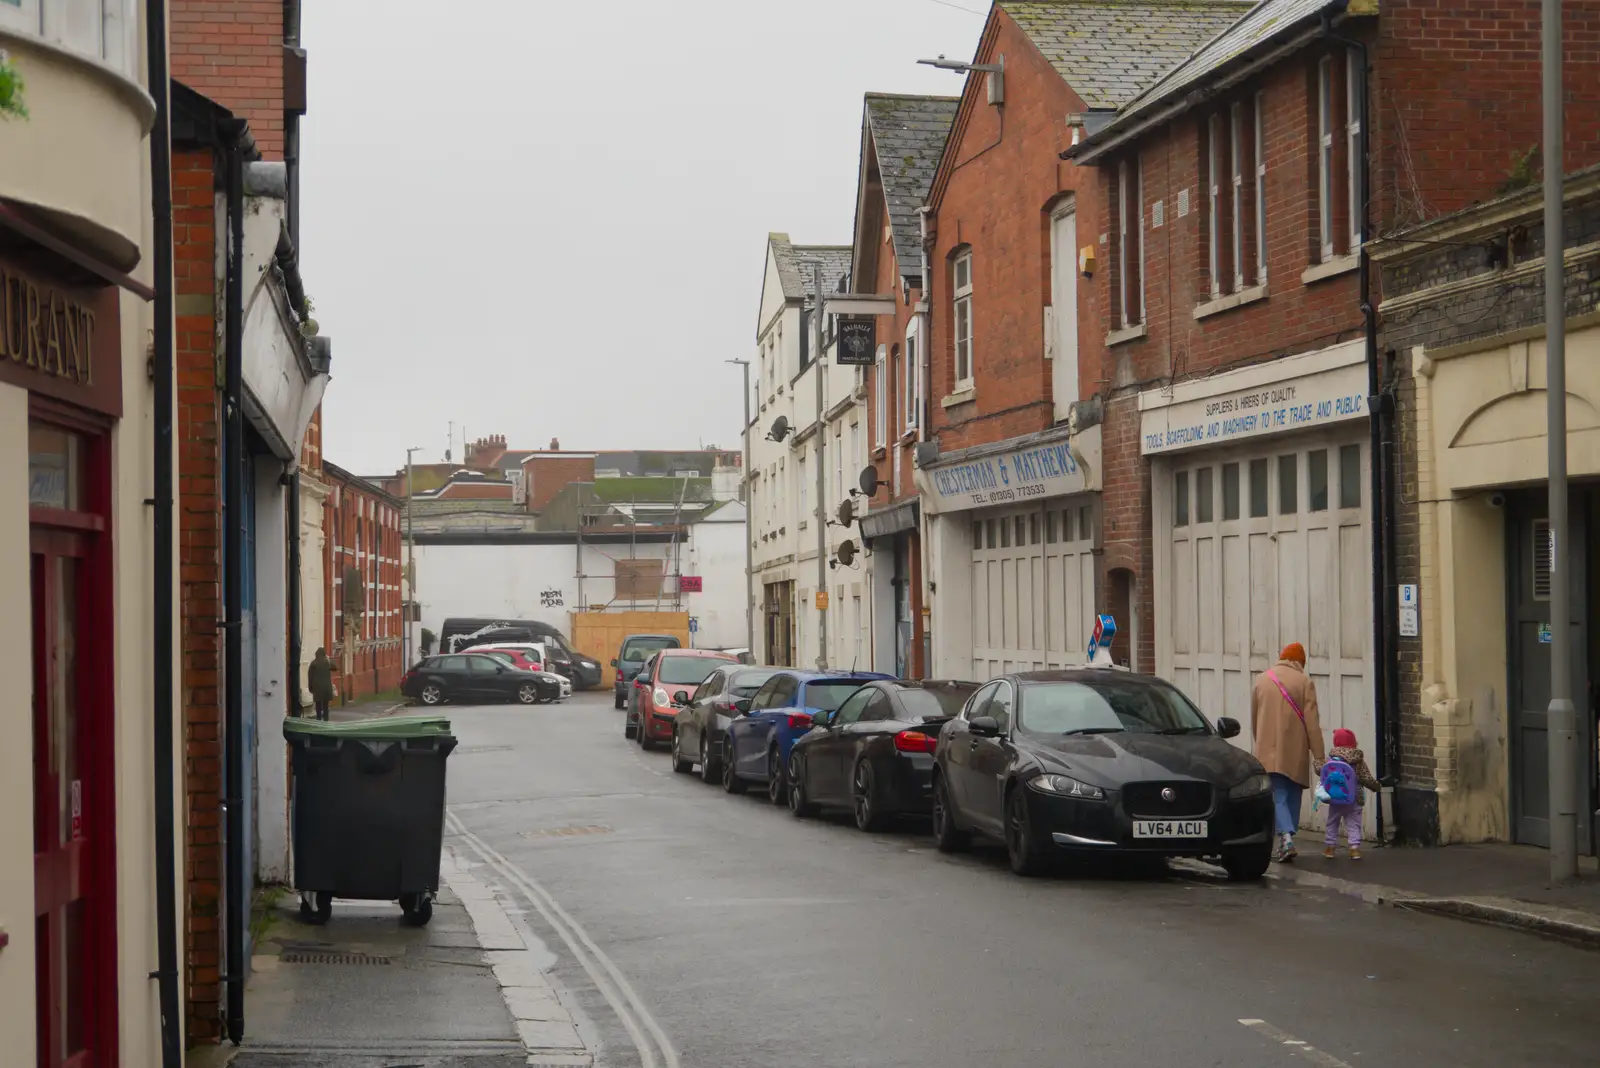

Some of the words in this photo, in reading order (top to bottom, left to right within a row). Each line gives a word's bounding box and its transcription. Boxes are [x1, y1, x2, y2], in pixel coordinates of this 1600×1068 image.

[0, 266, 95, 386] URANT
[1166, 424, 1204, 446] SCAFFOLDING
[1206, 421, 1219, 439] AND
[1222, 413, 1258, 437] MACHINERY
[1261, 411, 1270, 429] TO
[1272, 408, 1286, 428] THE
[1289, 403, 1313, 425] TRADE
[1316, 399, 1332, 420] AND
[1335, 393, 1362, 417] PUBLIC
[1206, 399, 1233, 417] SUPPLIERS
[1234, 398, 1239, 411] &
[1240, 394, 1260, 410] HIRERS
[1261, 391, 1269, 406] OF
[934, 460, 998, 497] CHESTERMAN
[998, 456, 1009, 486] &
[1012, 443, 1077, 485] MATTHEWS
[972, 494, 988, 504] TEL:
[990, 488, 1015, 504] (01305)
[1016, 483, 1046, 498] 773533
[1138, 822, 1173, 835] LV64
[1176, 822, 1202, 835] ACU
